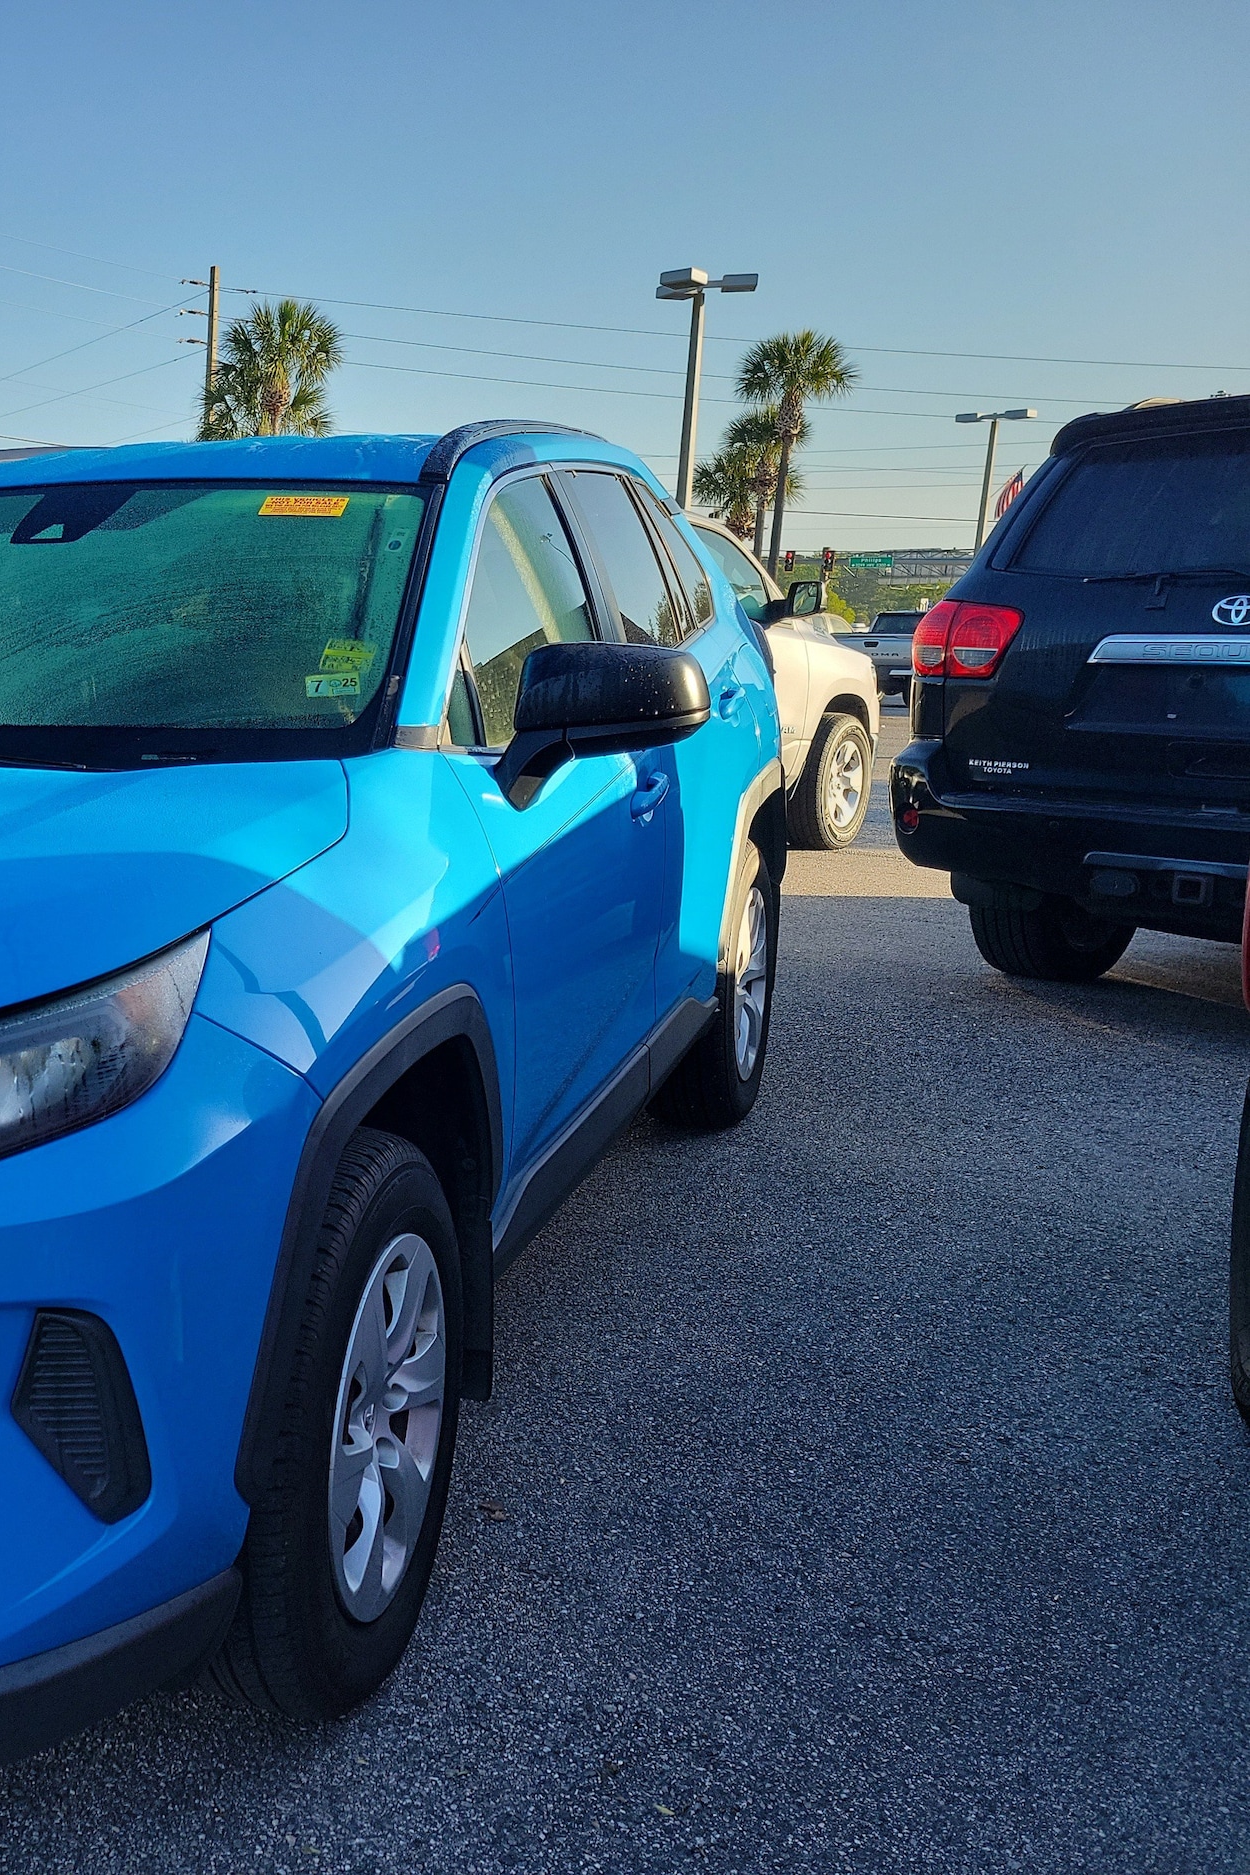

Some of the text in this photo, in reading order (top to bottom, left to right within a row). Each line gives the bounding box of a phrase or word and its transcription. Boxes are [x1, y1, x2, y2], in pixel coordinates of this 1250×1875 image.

[1143, 644, 1250, 659] SEQU
[310, 680, 323, 693] 7
[341, 677, 357, 687] 25
[969, 759, 1029, 769] KEITH PIERSON
